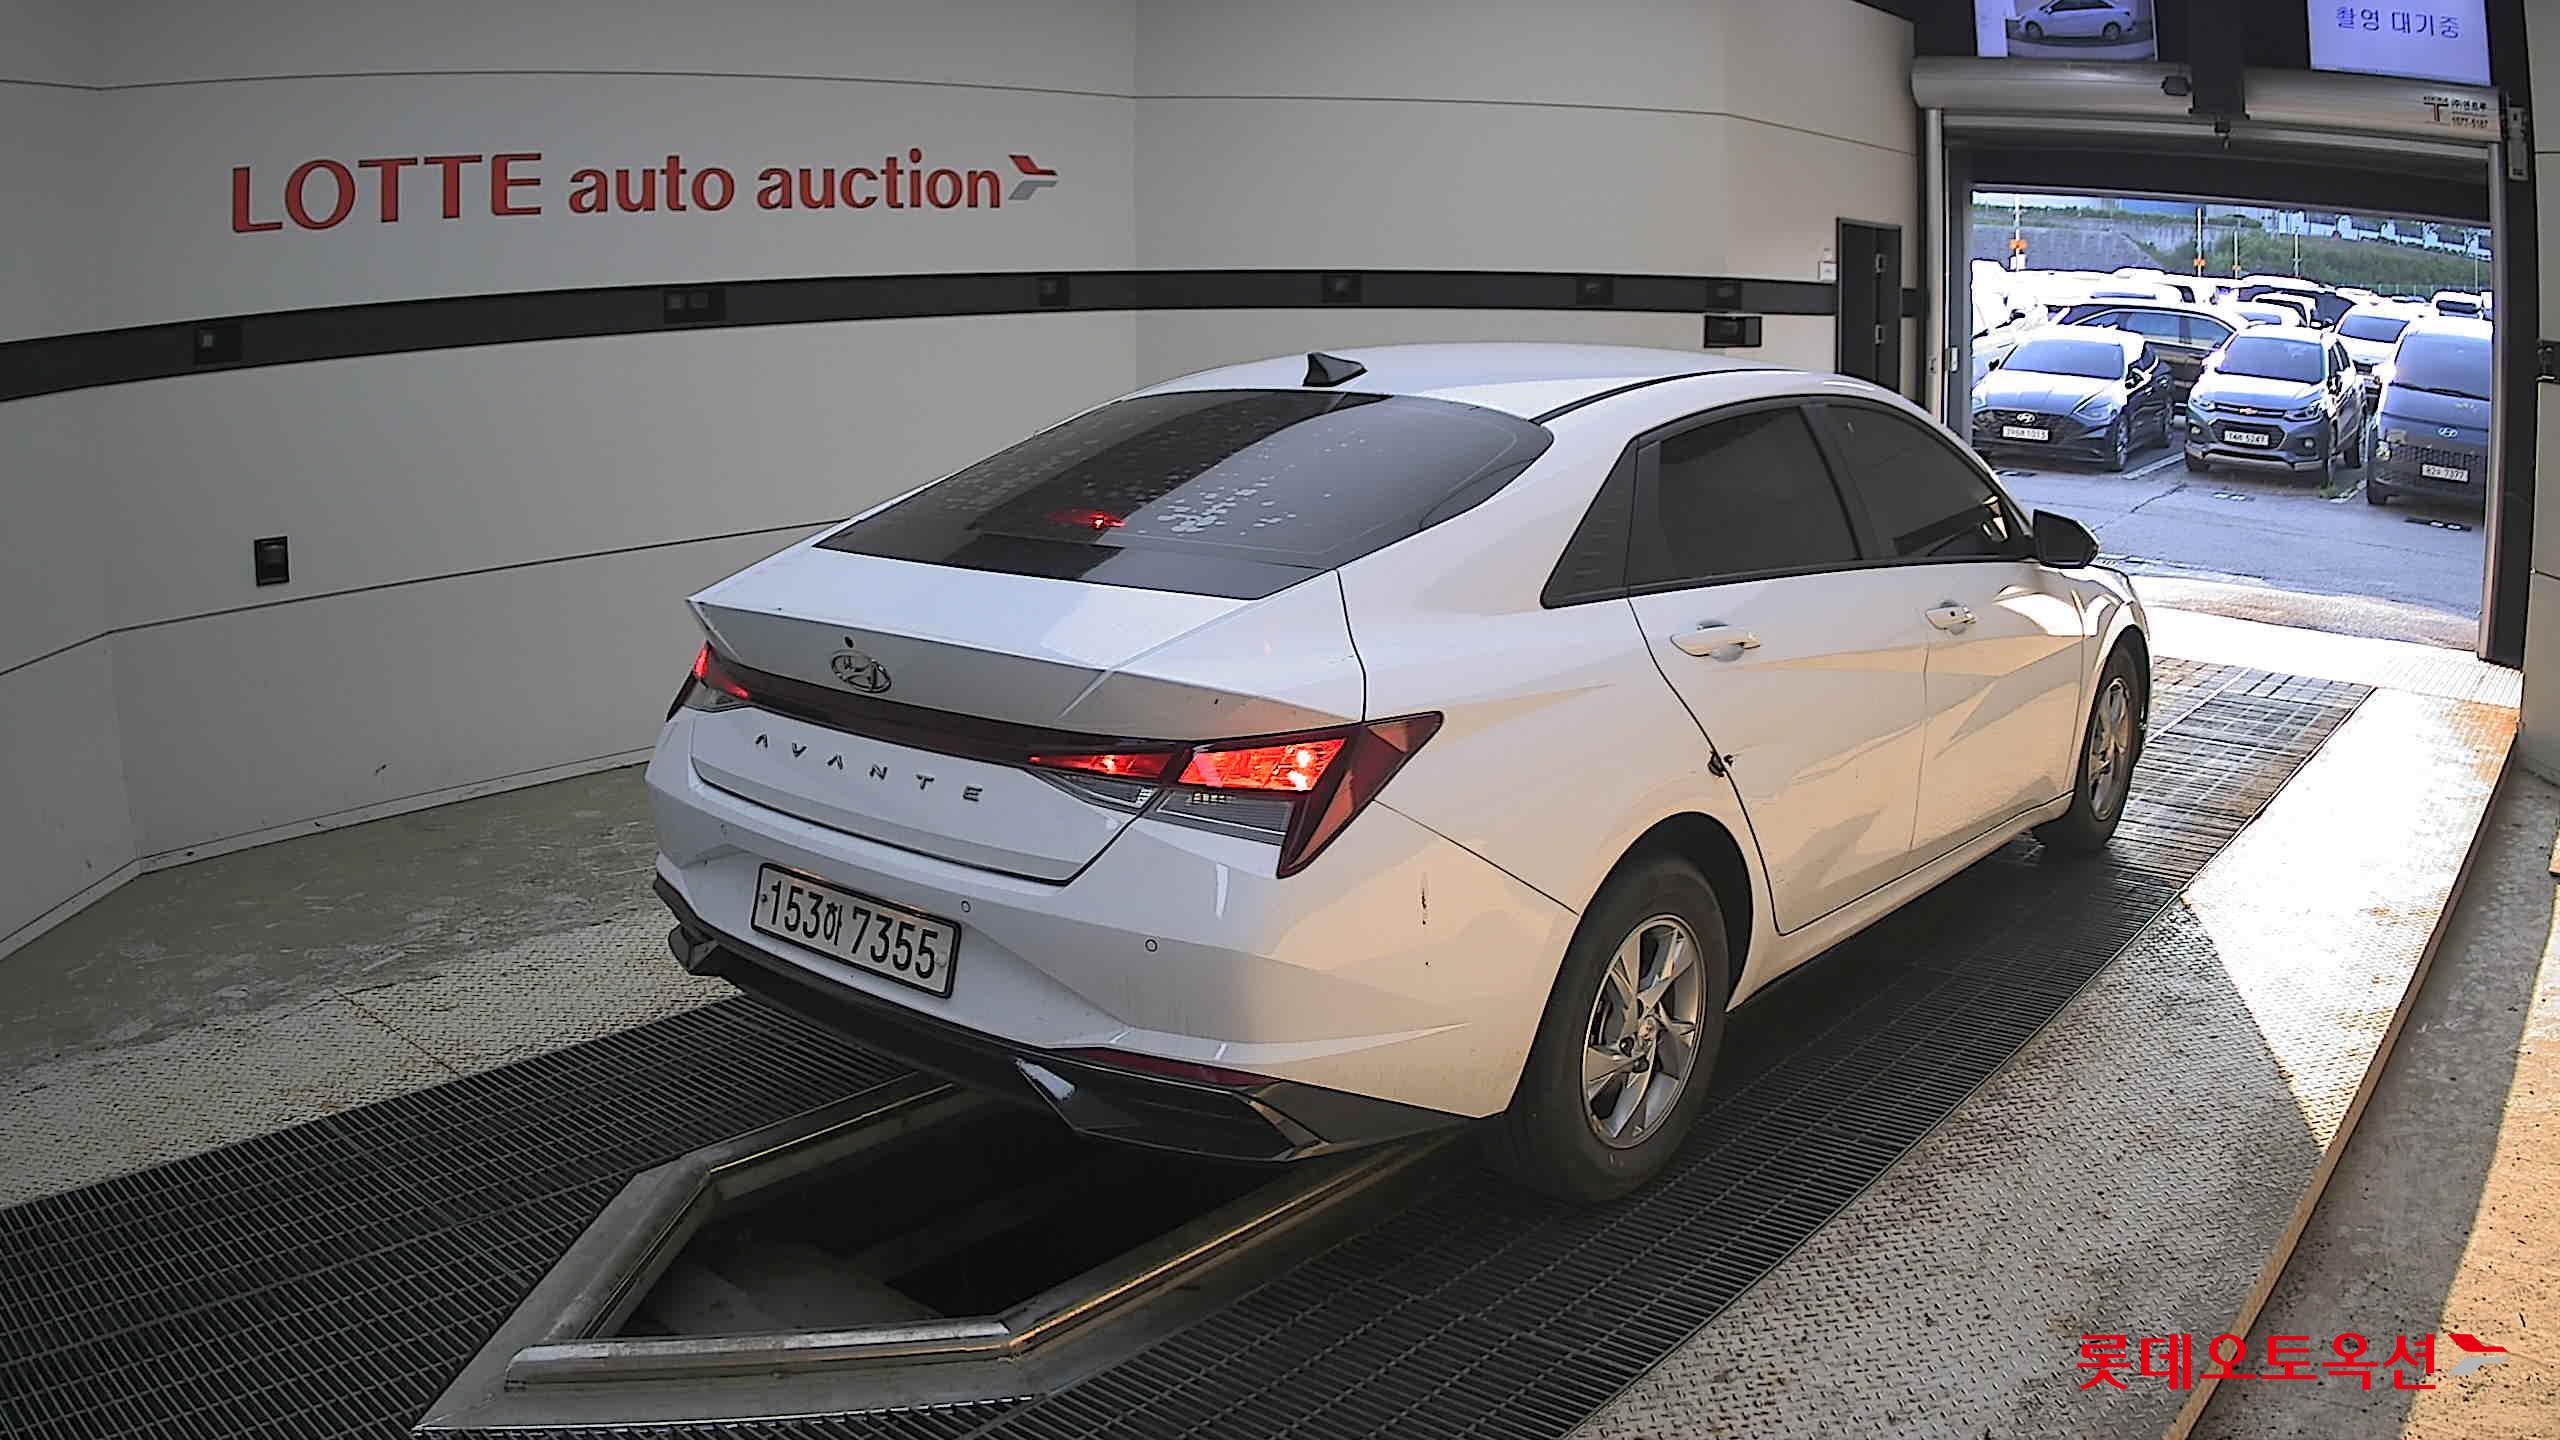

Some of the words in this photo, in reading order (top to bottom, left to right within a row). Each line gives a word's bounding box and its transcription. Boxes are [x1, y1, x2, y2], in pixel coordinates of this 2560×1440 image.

[2336, 6, 2380, 31] 촬영
[2391, 11, 2459, 39] 대기중
[232, 152, 543, 234] LOTTE
[568, 155, 736, 214] auto
[756, 147, 1001, 211] auction
[755, 733, 983, 803] AVANTE
[770, 879, 844, 947] 153하
[850, 906, 939, 980] 7355
